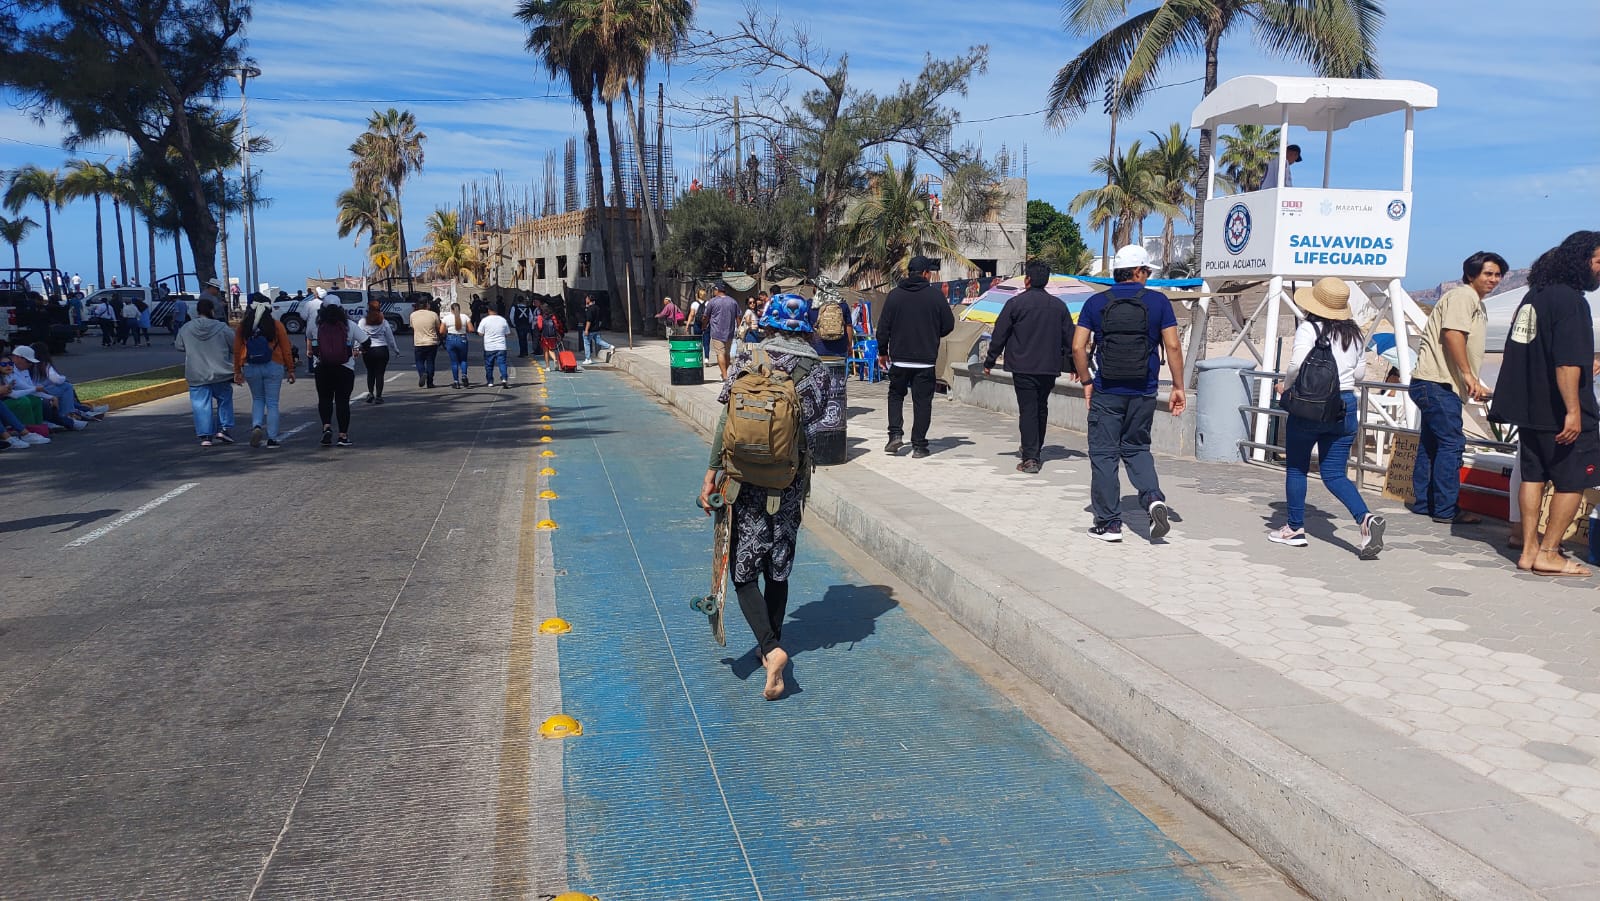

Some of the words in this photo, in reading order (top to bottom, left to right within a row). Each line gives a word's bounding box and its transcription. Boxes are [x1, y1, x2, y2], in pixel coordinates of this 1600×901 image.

[1335, 203, 1373, 211] MAZATLÁN
[1289, 234, 1394, 250] SALVAVIDAS
[1205, 261, 1230, 270] POLICIA
[1233, 259, 1267, 269] ACUATICA
[1294, 252, 1388, 266] LIFEGUARD
